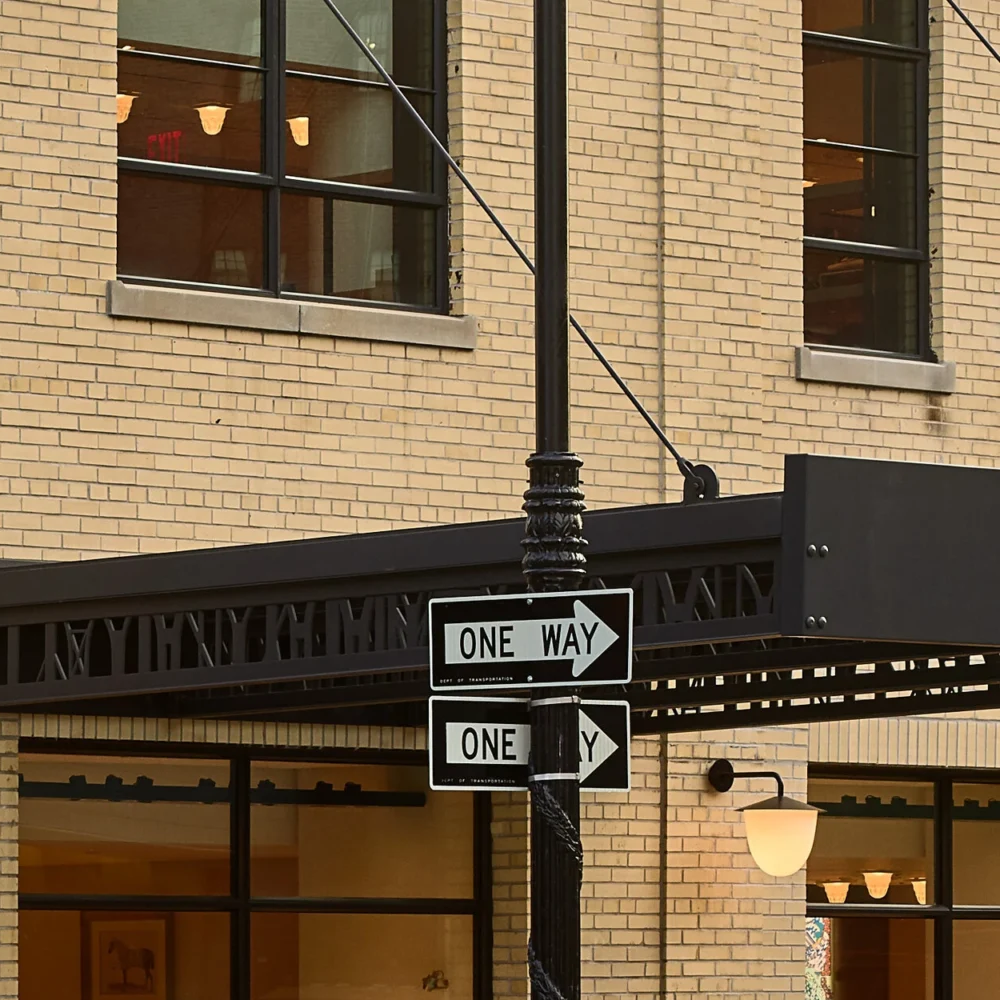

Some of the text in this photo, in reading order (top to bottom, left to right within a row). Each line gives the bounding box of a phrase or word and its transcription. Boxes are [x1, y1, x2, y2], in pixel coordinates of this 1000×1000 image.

[459, 622, 600, 660] ONE WAY
[461, 727, 517, 761] ONE
